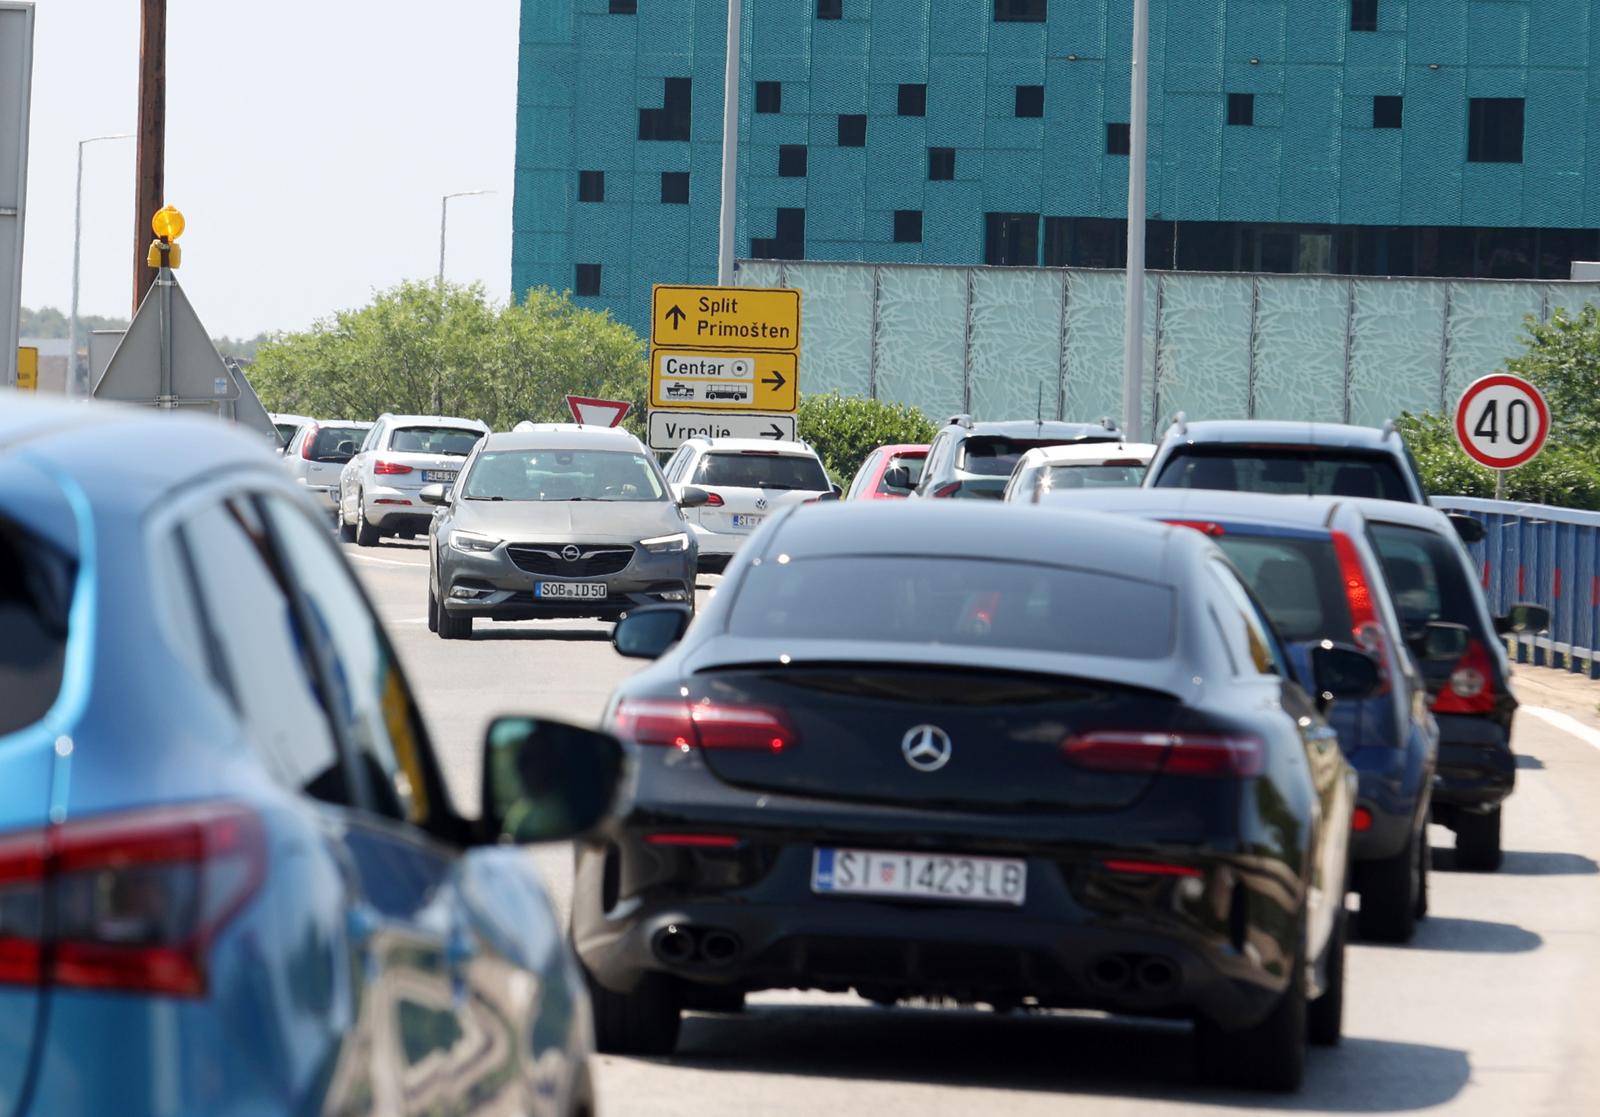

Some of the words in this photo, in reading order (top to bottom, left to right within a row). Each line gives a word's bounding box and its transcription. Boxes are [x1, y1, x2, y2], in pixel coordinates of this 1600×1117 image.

[699, 296, 738, 316] Split
[697, 320, 789, 338] Primošten
[666, 359, 724, 375] Centar
[1474, 399, 1529, 445] 40
[542, 583, 566, 596] SOB
[838, 853, 872, 887] SI
